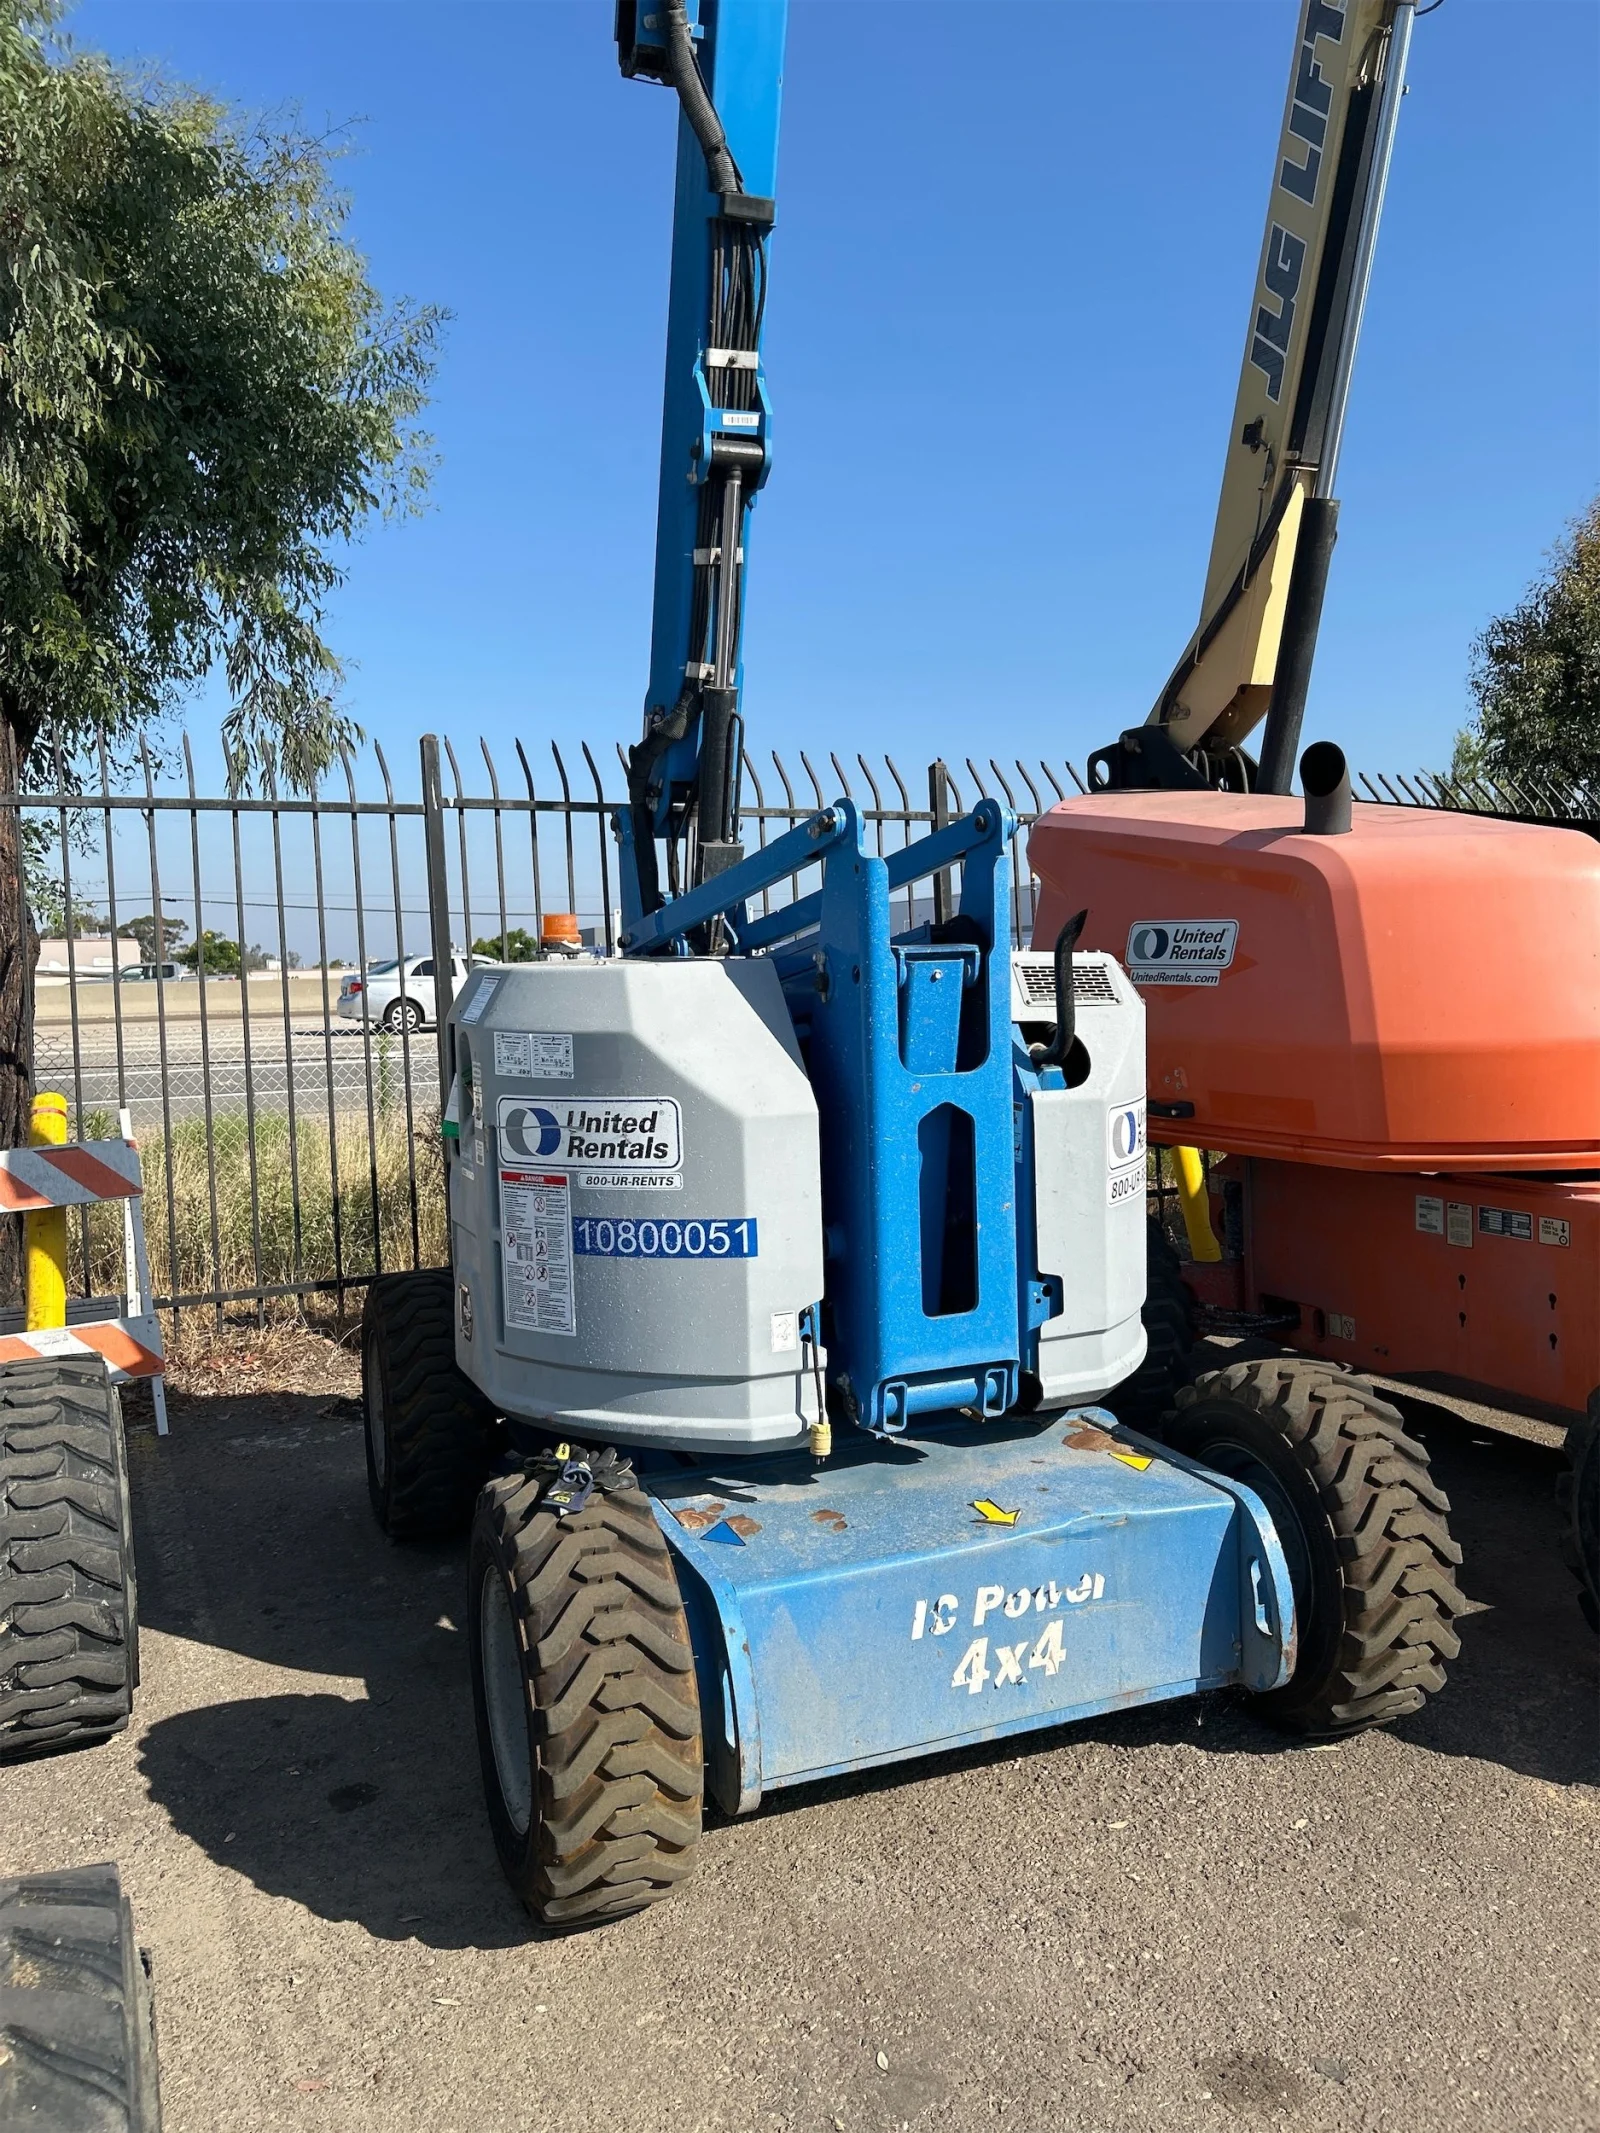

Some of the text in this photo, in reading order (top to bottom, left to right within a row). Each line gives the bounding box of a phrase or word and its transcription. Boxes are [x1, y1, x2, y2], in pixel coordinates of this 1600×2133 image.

[1249, 222, 1308, 404] JLG
[1173, 927, 1226, 944] United
[1169, 945, 1227, 961] Rentals
[1131, 971, 1219, 984] UnitedRentals.com
[567, 1110, 658, 1134] United
[567, 1136, 669, 1160] Rentals
[524, 1175, 545, 1183] DANGER
[585, 1176, 675, 1187] 800-UR-RENTS
[578, 1220, 751, 1255] 10800051
[911, 1593, 959, 1641] IC
[951, 1619, 1067, 1695] 4x4
